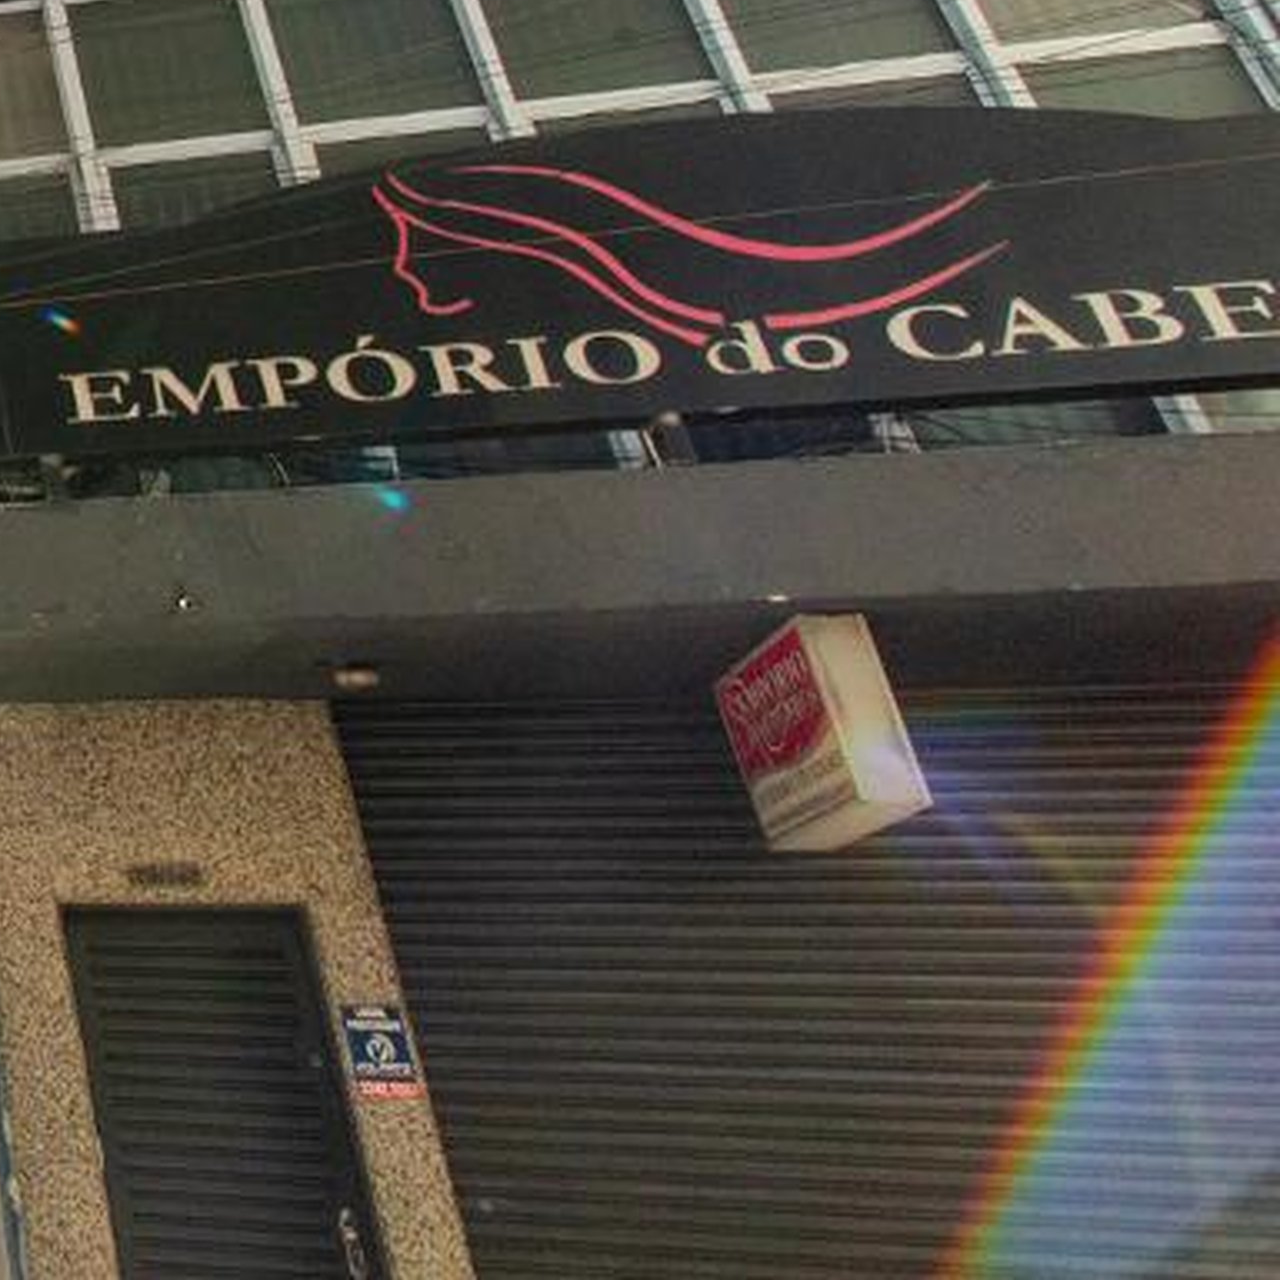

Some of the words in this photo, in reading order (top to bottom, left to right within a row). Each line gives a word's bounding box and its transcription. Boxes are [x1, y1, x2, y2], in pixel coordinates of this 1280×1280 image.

[57, 329, 662, 424] EMPÓRIO
[705, 321, 850, 376] do
[885, 279, 1280, 362] CABE
